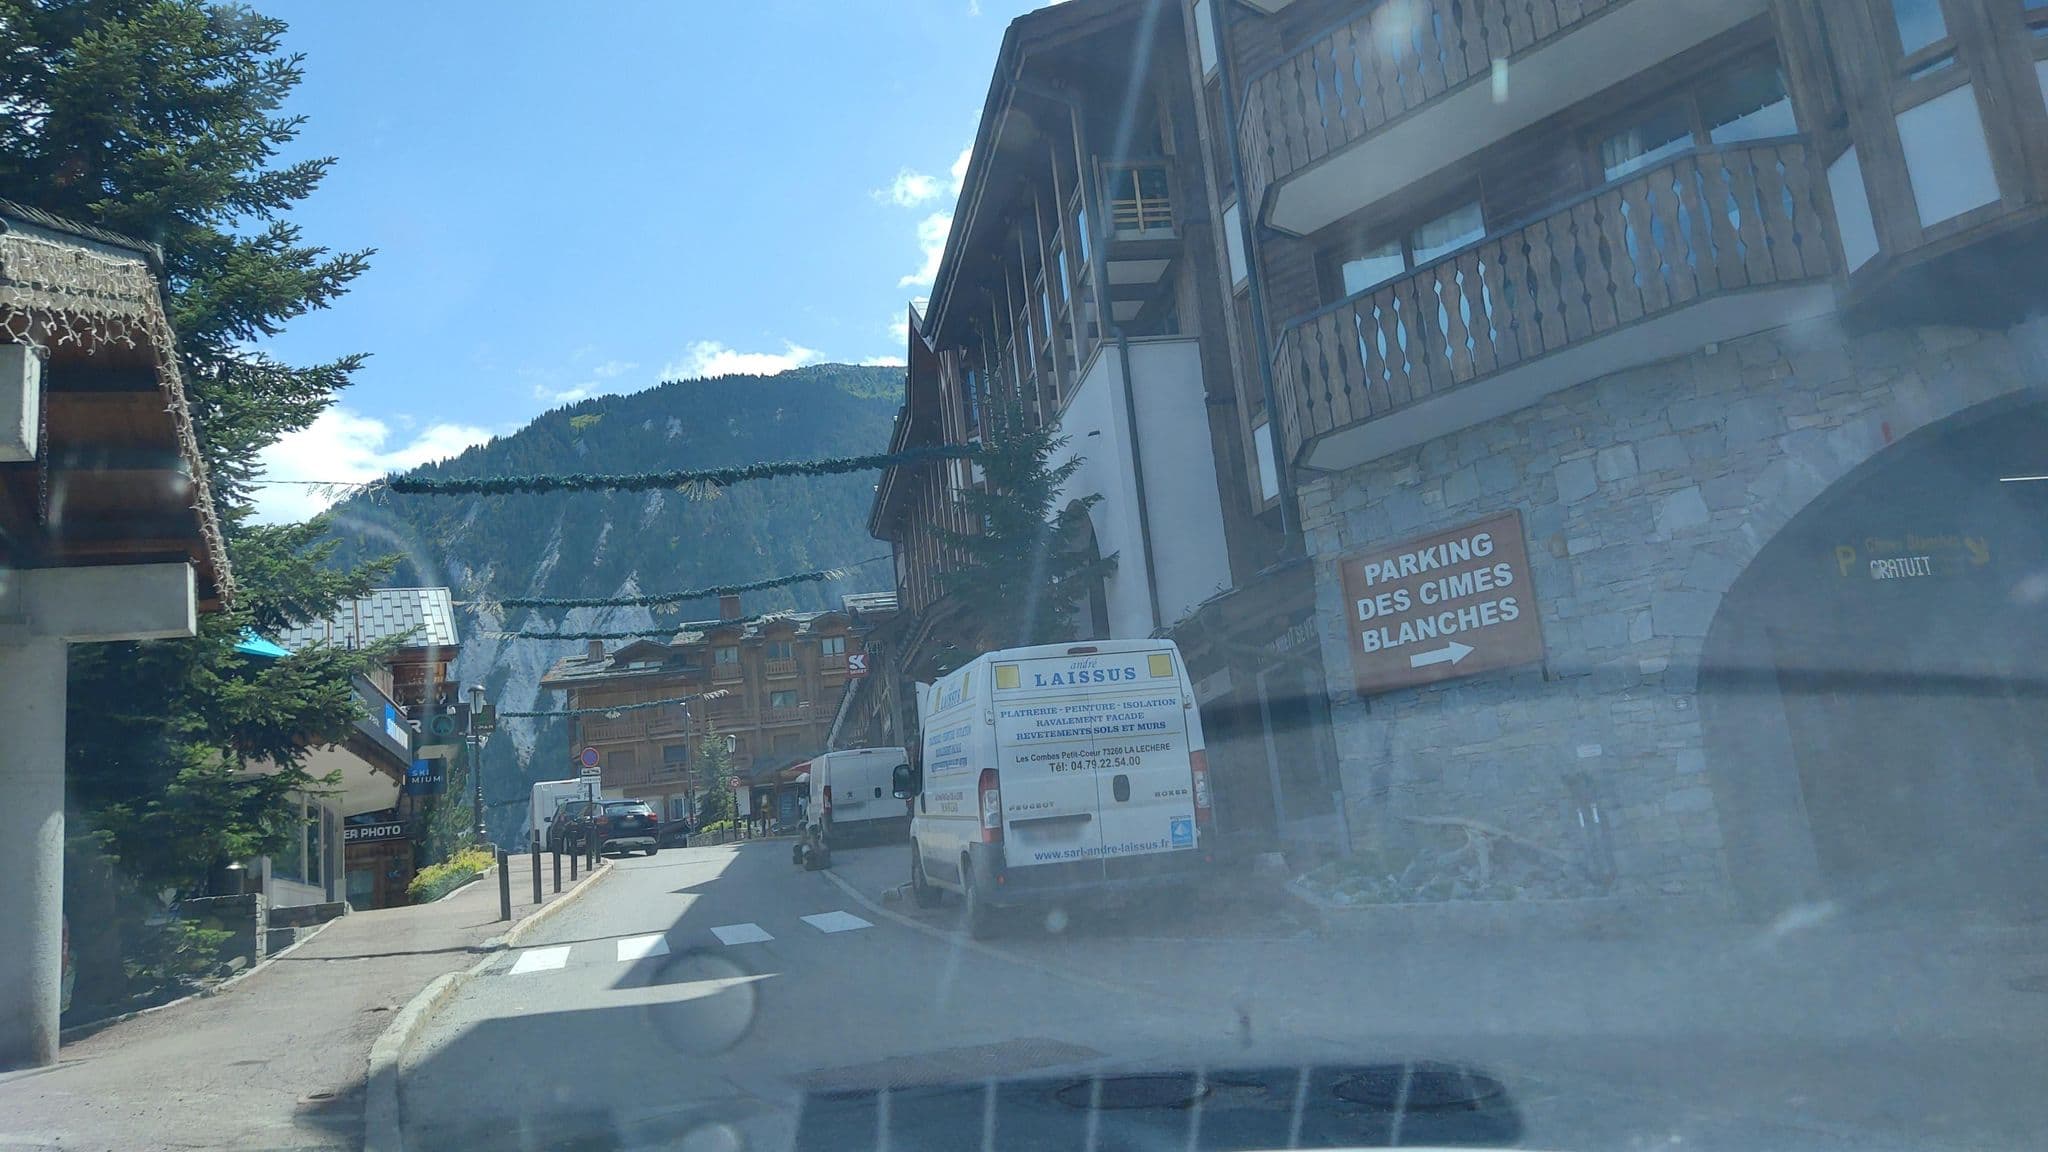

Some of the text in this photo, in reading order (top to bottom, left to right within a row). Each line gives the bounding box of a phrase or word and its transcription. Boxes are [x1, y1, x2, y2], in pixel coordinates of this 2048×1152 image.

[1364, 532, 1495, 587] PARKING
[1834, 545, 1857, 577] P
[1869, 556, 1932, 580] GRATUIT
[1357, 562, 1515, 622] DES CIMES
[1361, 596, 1521, 654] BLANCHES
[1070, 657, 1098, 670] andré
[1034, 667, 1138, 688] LAISSUS
[1000, 698, 1177, 719] PLATRERIE PEINTURE ISOLATION
[1036, 711, 1146, 728] RAVALEMENT FACADE
[1016, 720, 1167, 742] REVETEMENTS SOLS ET MURS
[1015, 755, 1030, 764] Les
[1102, 747, 1124, 757] 73260
[1124, 745, 1136, 755] LA
[1049, 755, 1141, 773] Tél: 04.79.22.54.00
[411, 769, 430, 777] SKI
[411, 775, 442, 785] MIUM
[1154, 788, 1189, 798] BOXER
[1008, 801, 1056, 812] PEUGEOT
[360, 825, 402, 838] PHOTO
[1034, 838, 1171, 861] www.sarl-andre-laissus.fr
